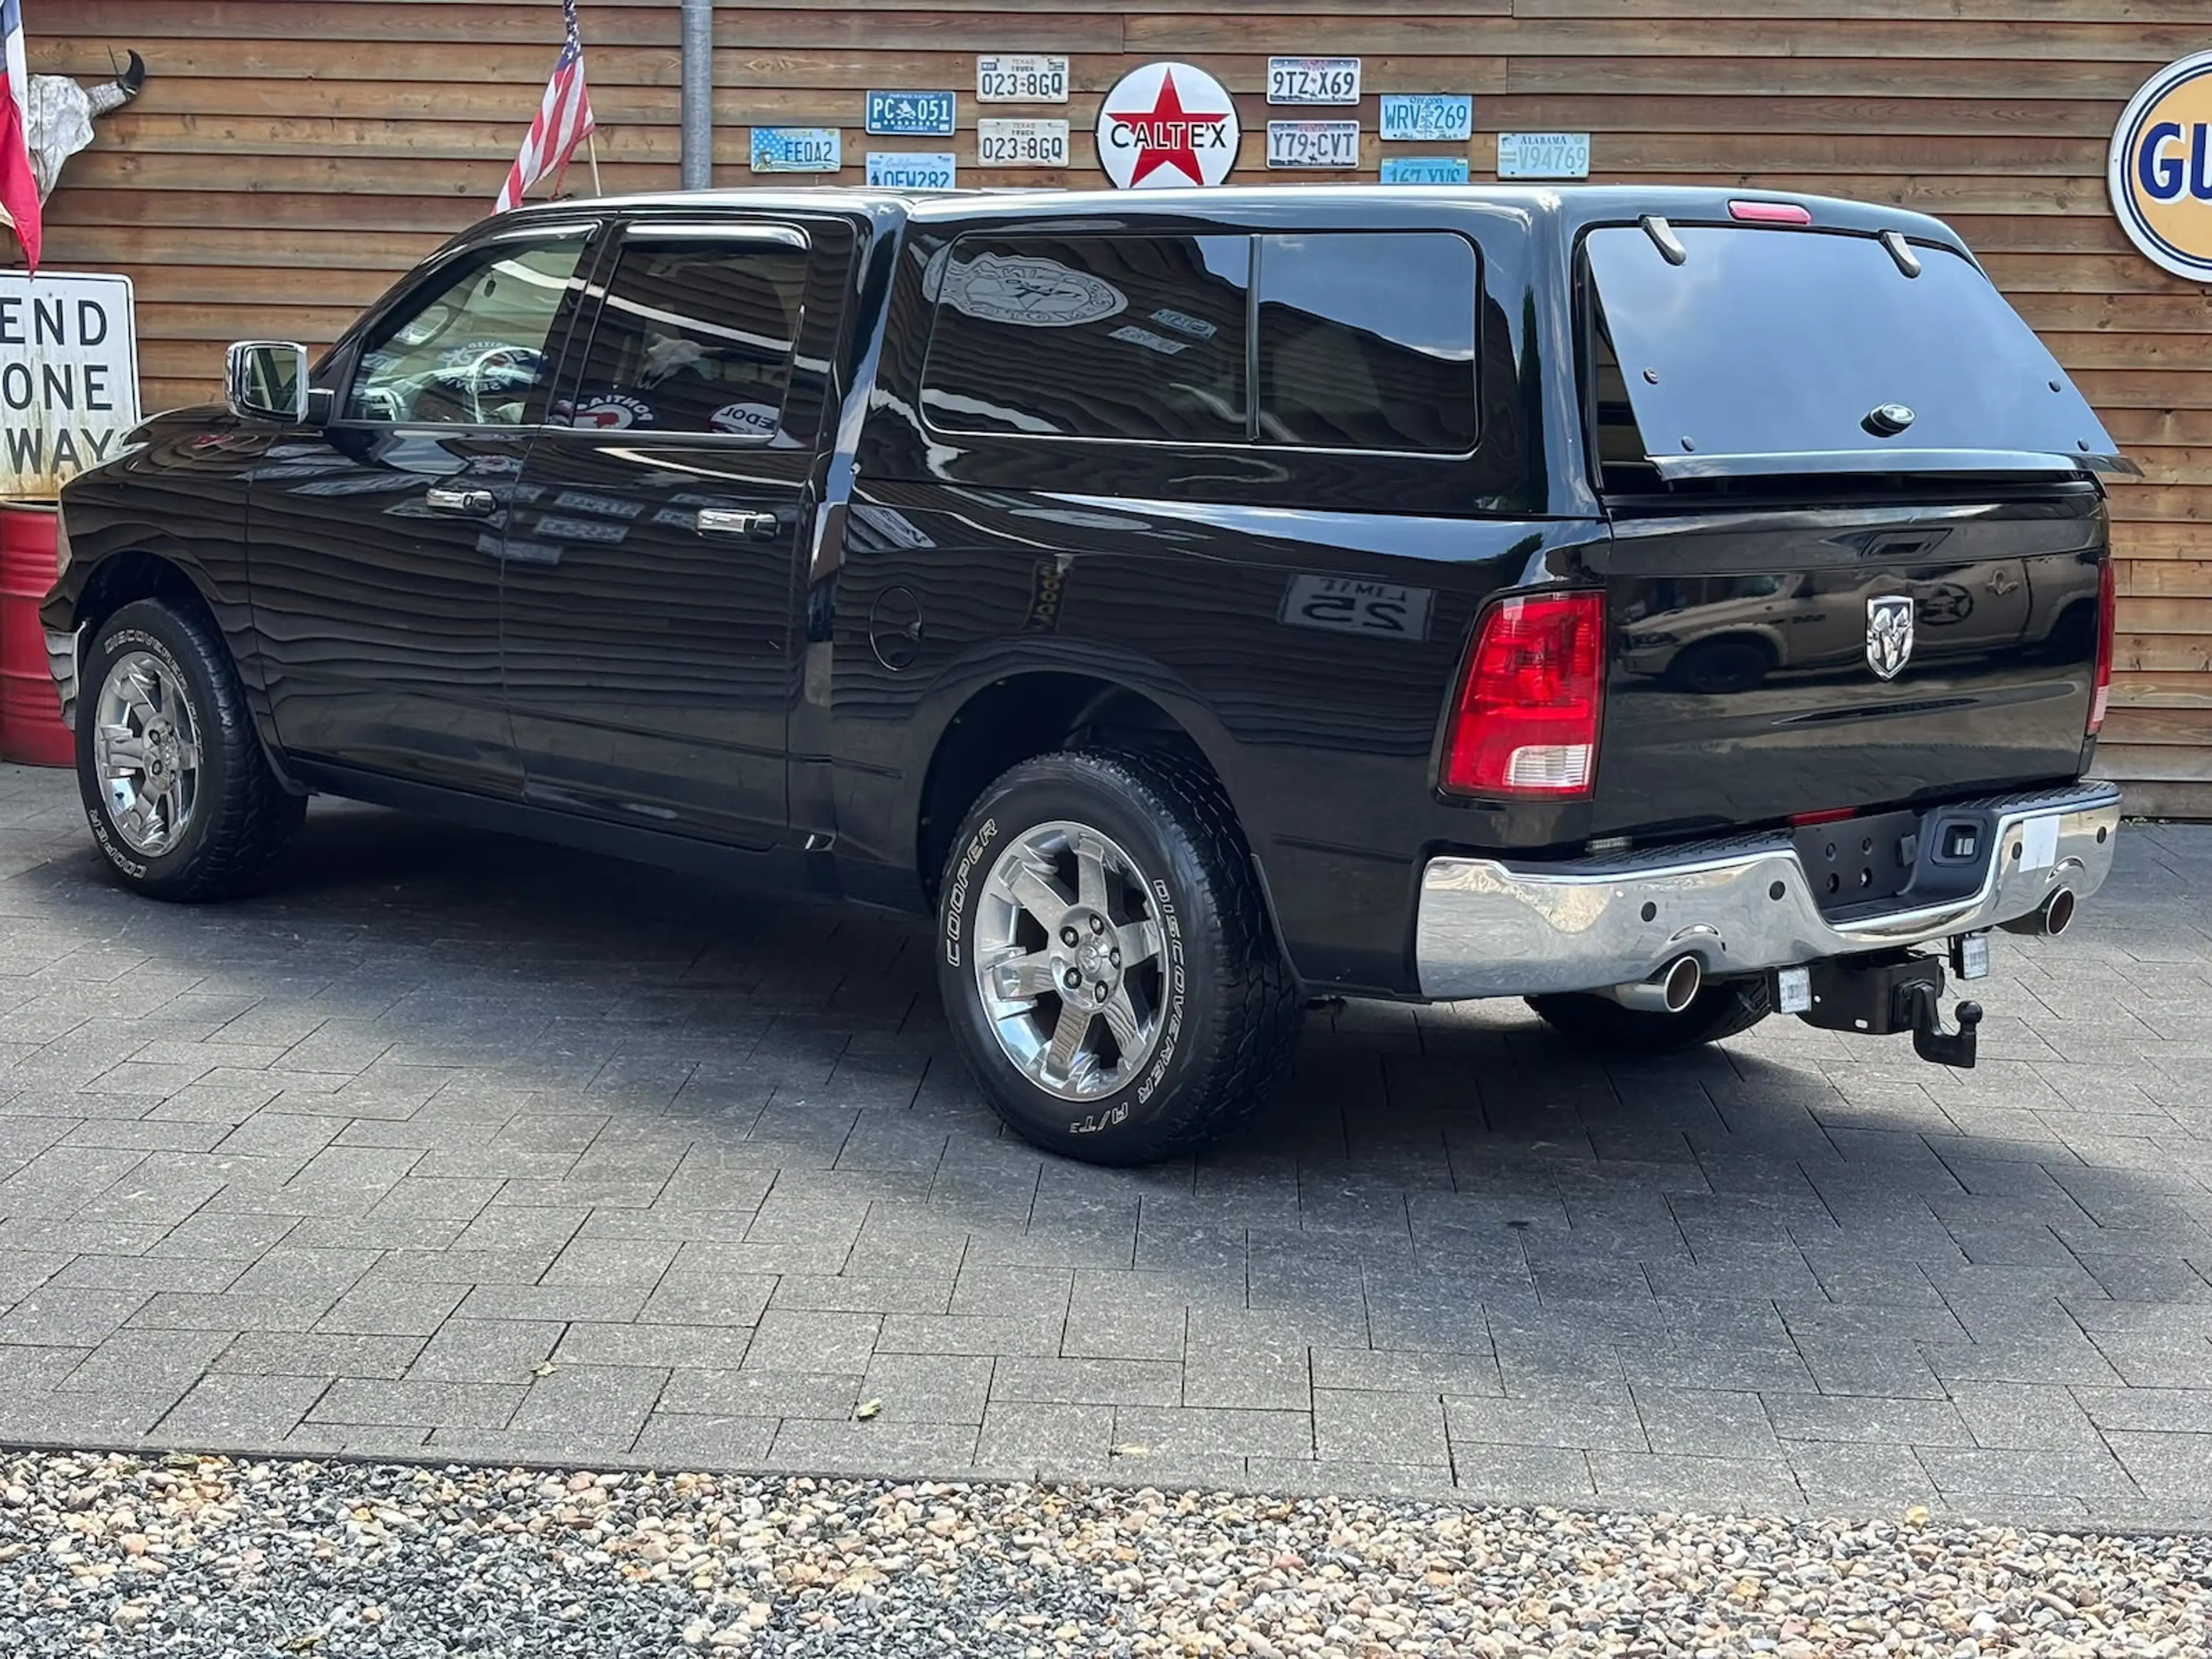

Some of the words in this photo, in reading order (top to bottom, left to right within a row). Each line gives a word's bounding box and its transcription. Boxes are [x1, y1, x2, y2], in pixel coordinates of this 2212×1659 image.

[873, 98, 894, 119] PC
[918, 99, 950, 120] 051
[1385, 104, 1421, 129] WRV
[1434, 105, 1467, 129] 269
[1111, 123, 1227, 149] CALTEX
[1518, 146, 1587, 169] V94769
[0, 297, 108, 346] END
[3, 362, 113, 410] ONE
[5, 428, 115, 475] WAY
[89, 809, 147, 878] COOPER
[946, 818, 998, 968] COOPER
[1138, 878, 1185, 1104] DISCOVERER
